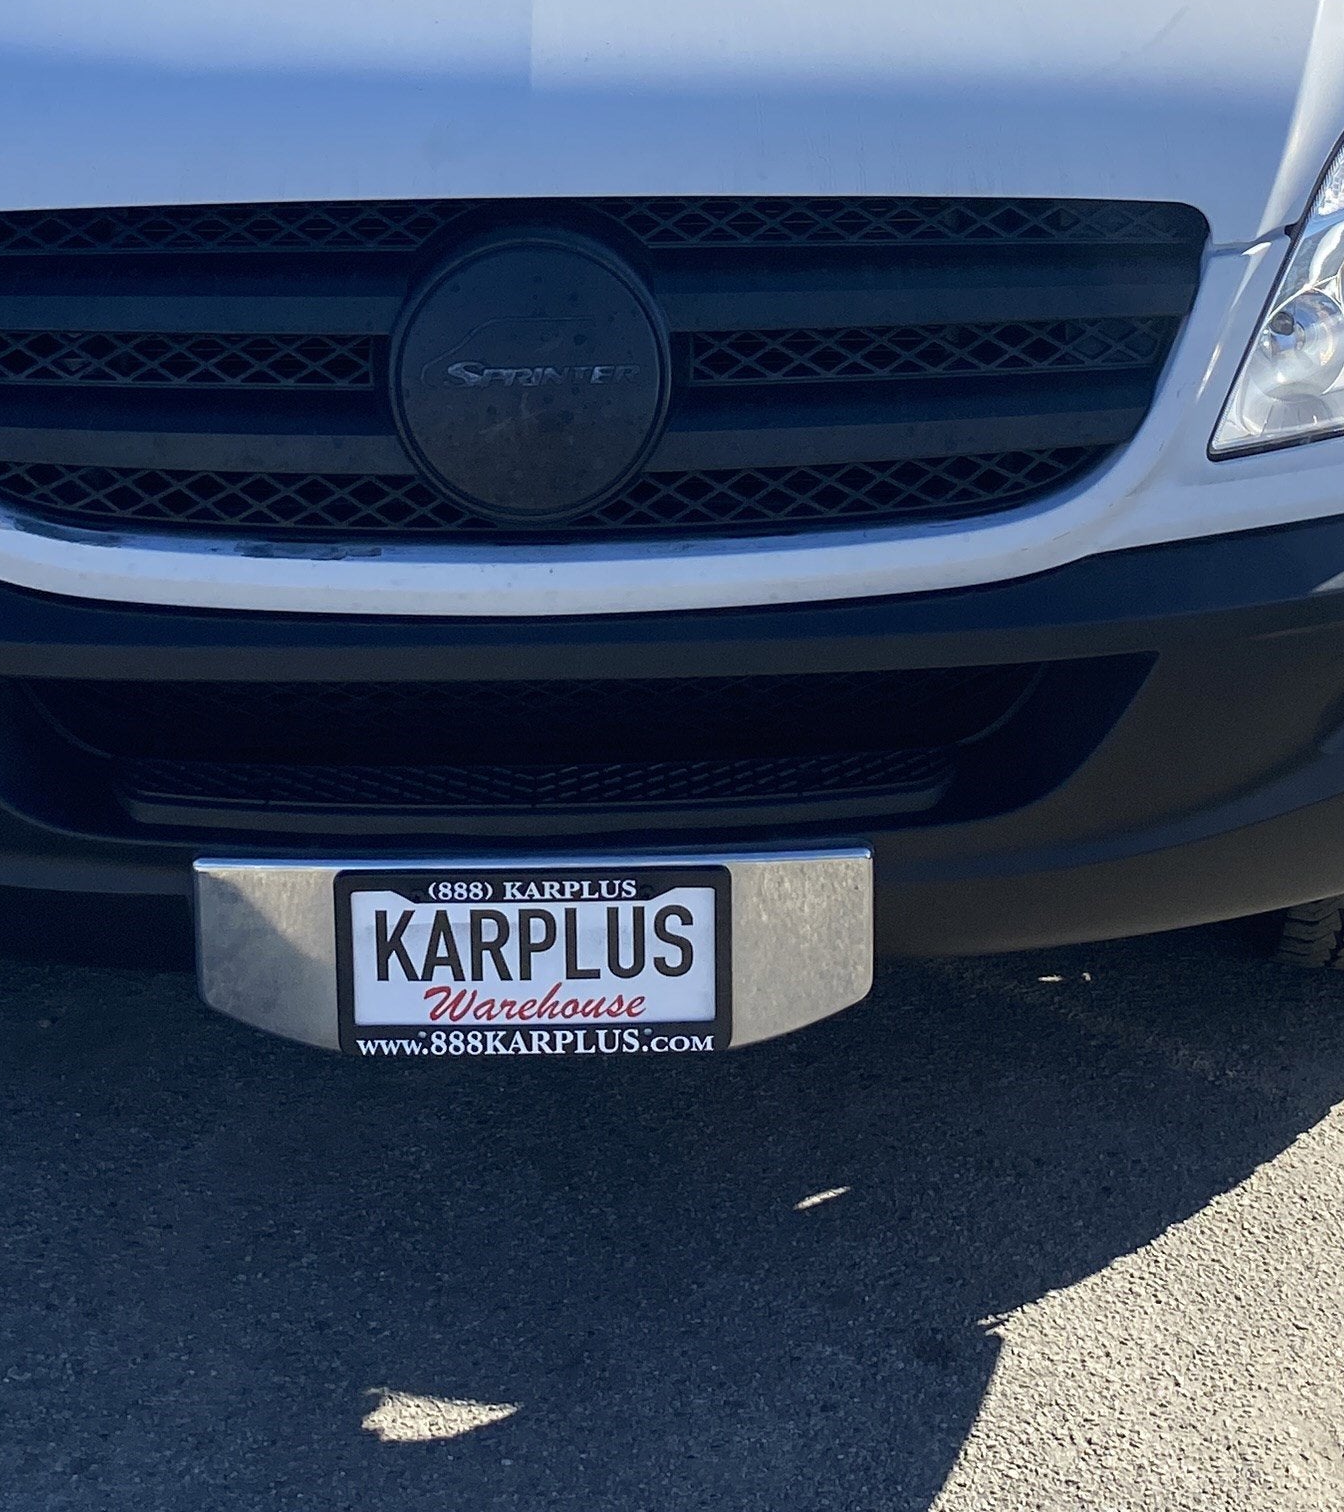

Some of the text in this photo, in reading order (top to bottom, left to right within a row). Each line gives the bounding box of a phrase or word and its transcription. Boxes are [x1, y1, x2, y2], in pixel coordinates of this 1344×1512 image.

[428, 879, 637, 901] (888) KARPLUS
[374, 904, 694, 983] KARPLUS
[422, 982, 646, 1023] Warehouse
